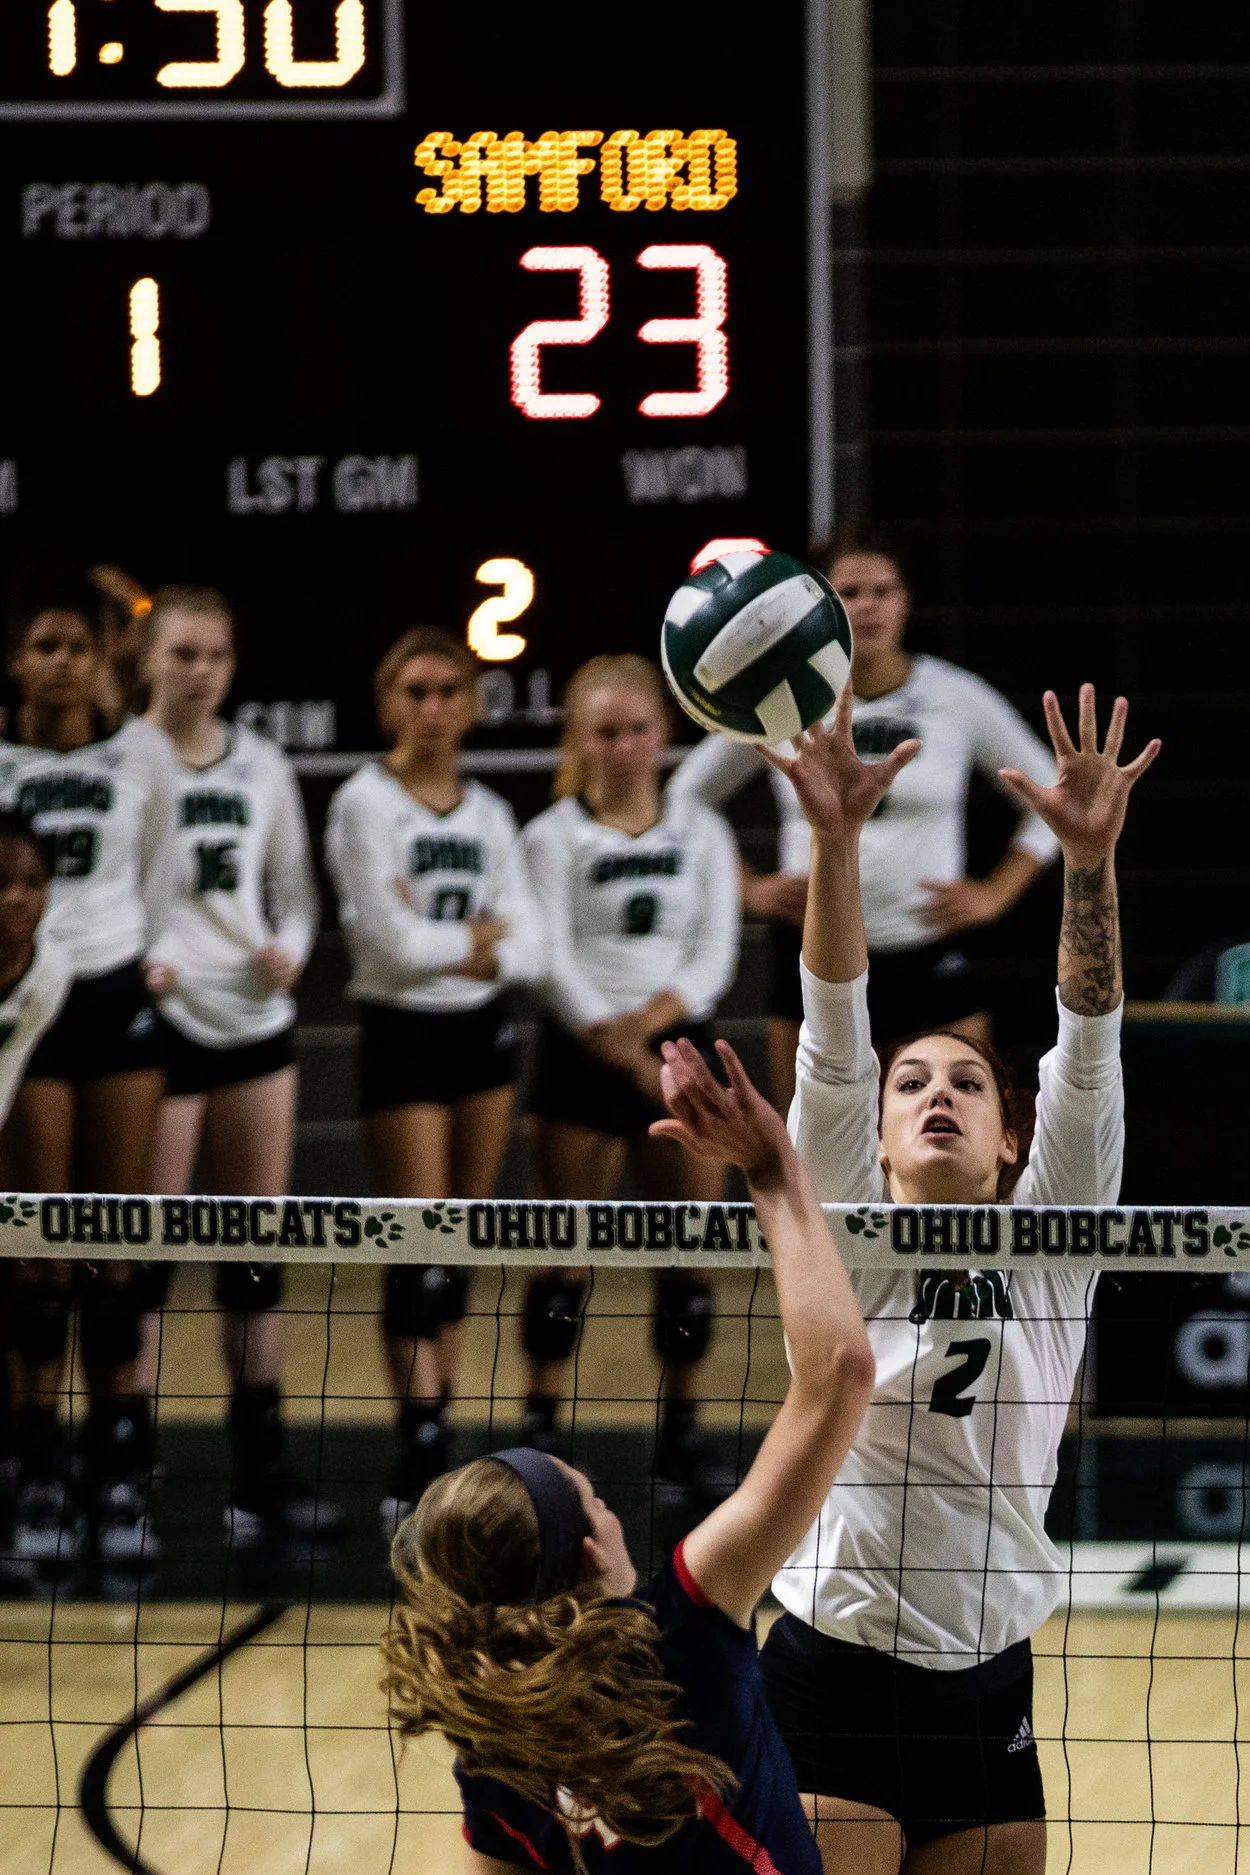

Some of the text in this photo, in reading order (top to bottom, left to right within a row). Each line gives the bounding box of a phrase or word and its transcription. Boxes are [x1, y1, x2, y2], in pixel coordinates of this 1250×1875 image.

[414, 129, 738, 213] SAMFORD
[20, 181, 212, 239] PERIOD
[129, 277, 161, 396] 1
[510, 244, 730, 420] 23
[228, 455, 420, 513] LST GM
[621, 446, 749, 503] WON
[467, 557, 535, 662] 2
[40, 1198, 362, 1247] OHIO BOBCATS
[467, 1202, 769, 1252] OHIO BOBCAT
[890, 1208, 1210, 1257] OHIO BOBCATS
[929, 1337, 991, 1418] 2
